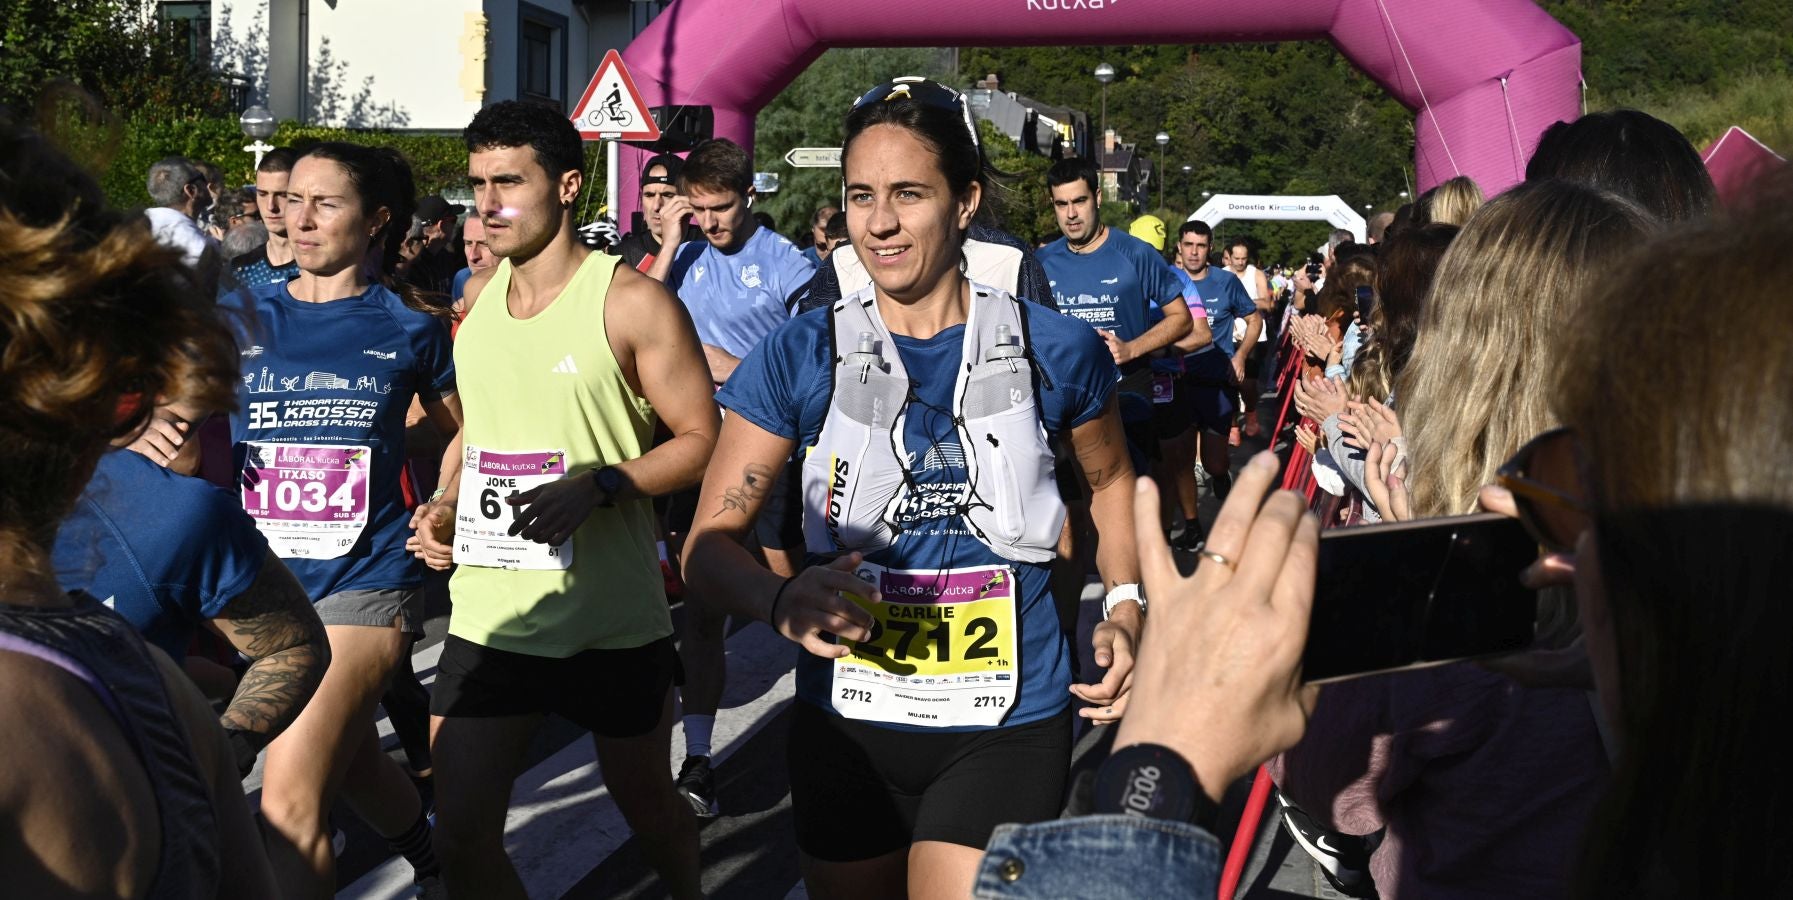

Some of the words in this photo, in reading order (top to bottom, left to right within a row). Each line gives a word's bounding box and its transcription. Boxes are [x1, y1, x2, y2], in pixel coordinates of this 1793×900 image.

[1228, 203, 1265, 211] Donostia
[291, 398, 378, 408] HONDARTZETAKO
[248, 401, 282, 429] 35.
[283, 406, 377, 419] KROSSA
[283, 419, 320, 427] CROSS
[329, 419, 374, 428] PLAYAS
[278, 455, 316, 464] LABORAL
[317, 456, 340, 465] kutxa
[480, 461, 511, 471] LABORAL
[512, 463, 536, 471] kutxa
[279, 469, 326, 480] ITXASO
[486, 477, 517, 488] JOKE
[254, 480, 356, 513] 1034
[480, 488, 523, 520] 61
[461, 543, 469, 552] 61
[548, 547, 559, 557] 61
[885, 584, 939, 596] LABORAL
[888, 605, 955, 619] CARLIE
[853, 616, 999, 663] 2712
[996, 659, 1009, 667] 1h
[841, 687, 872, 703] 2712
[974, 696, 1006, 708] 2712
[907, 711, 931, 719] MUJER
